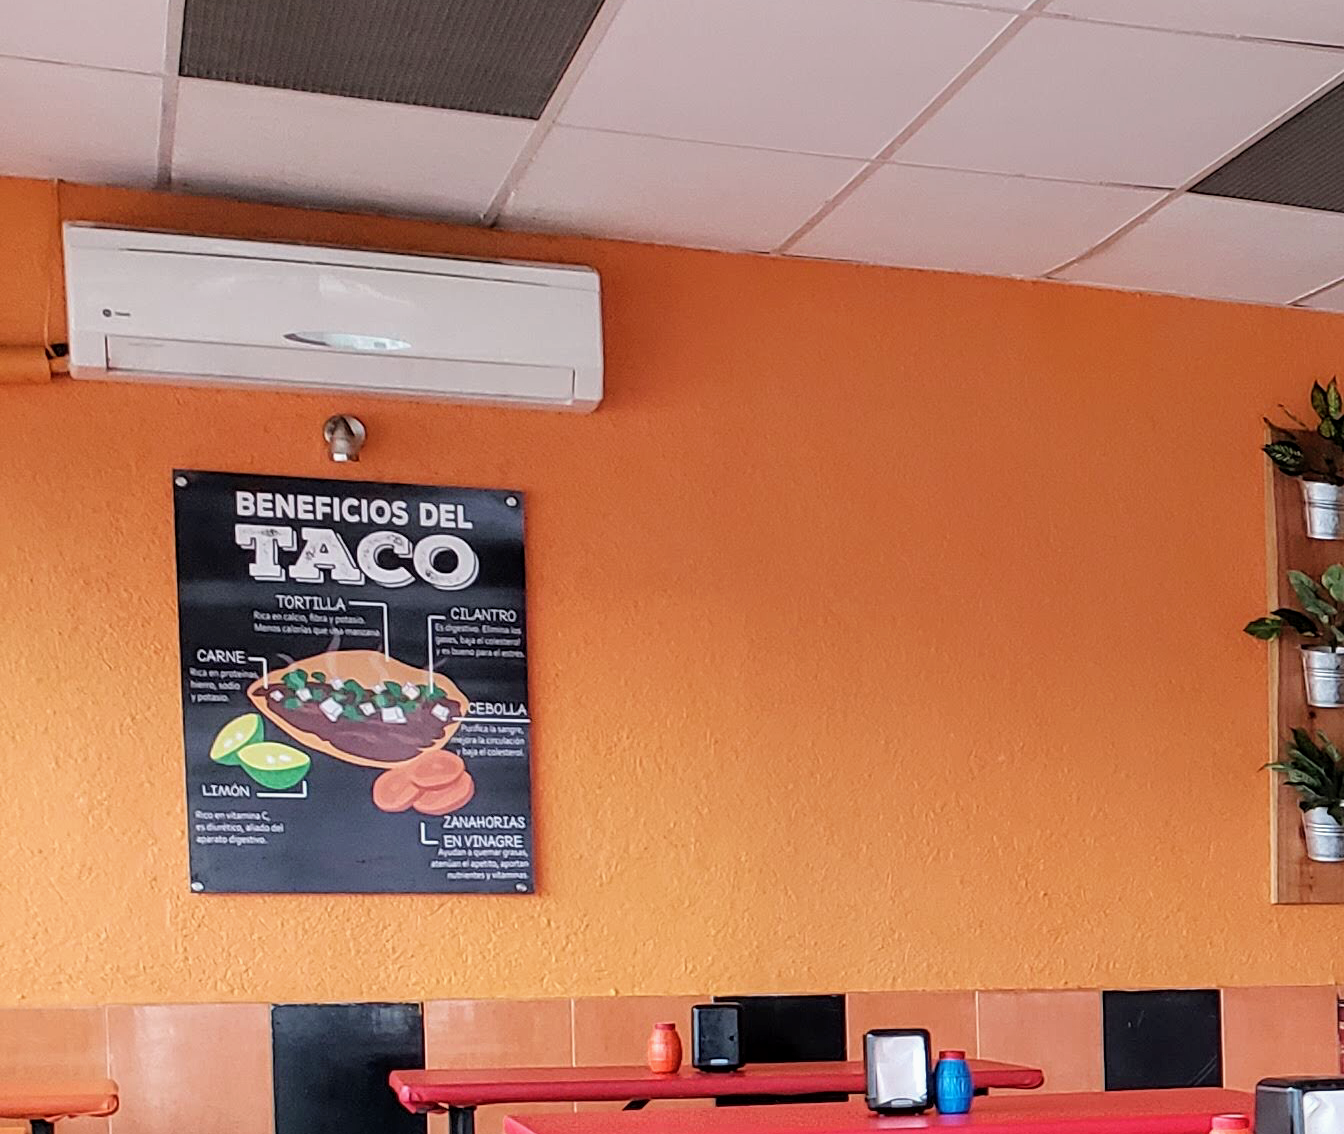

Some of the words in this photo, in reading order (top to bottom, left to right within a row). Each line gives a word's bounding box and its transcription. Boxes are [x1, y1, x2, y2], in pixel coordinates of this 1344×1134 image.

[236, 491, 410, 526] BENEFICIOS
[419, 502, 474, 529] DEL
[235, 523, 480, 591] TACO
[275, 594, 346, 611] TORTILLA
[450, 606, 517, 622] CILANTRO
[196, 648, 247, 664] CARNE
[468, 702, 528, 716] CEBOLLA
[202, 782, 251, 797] LIMÓN
[443, 815, 526, 829] ZANAHORIAS
[443, 835, 462, 848] EN
[464, 835, 524, 848] VINAGRE
